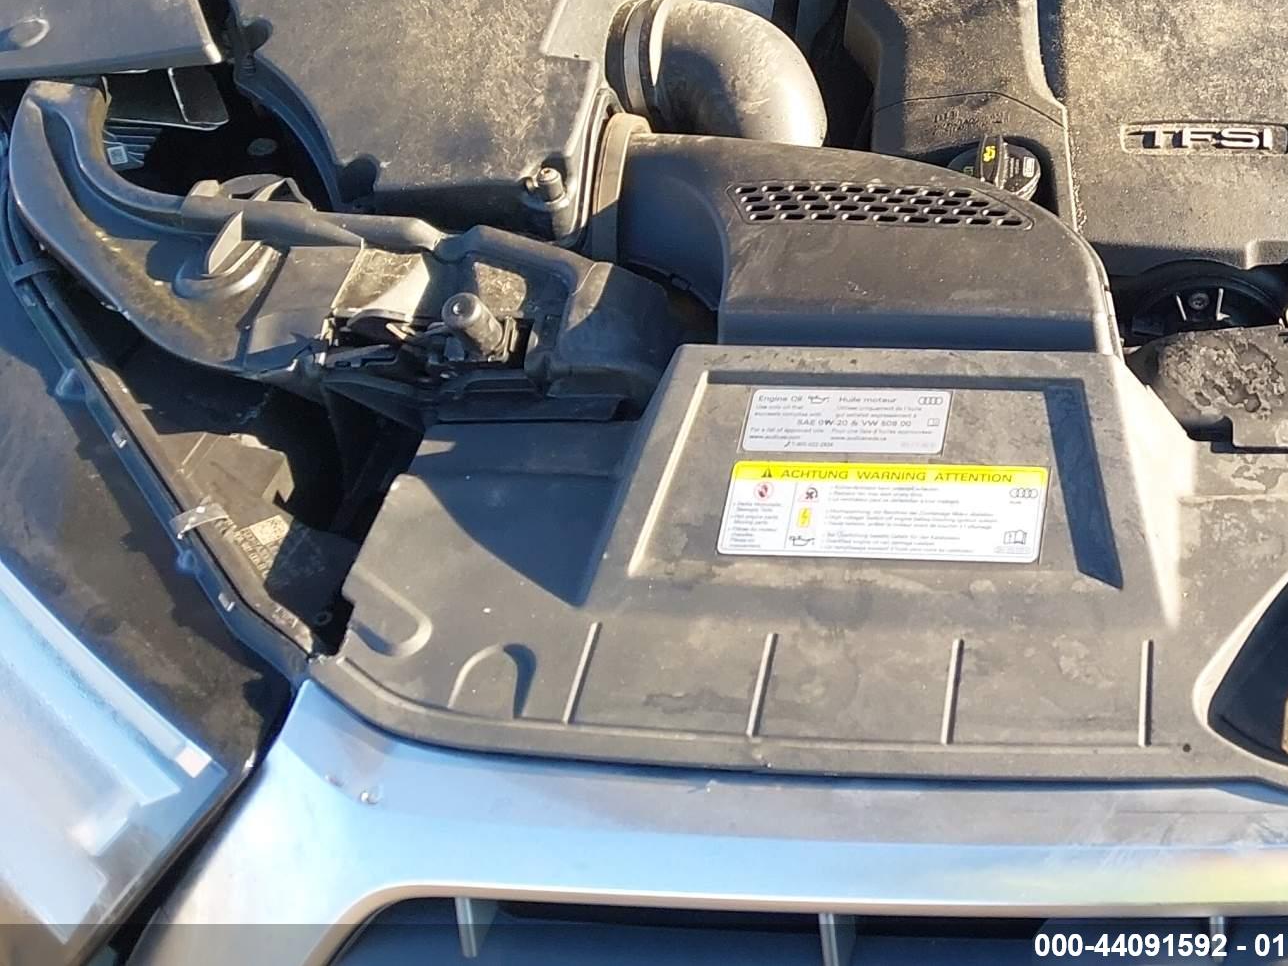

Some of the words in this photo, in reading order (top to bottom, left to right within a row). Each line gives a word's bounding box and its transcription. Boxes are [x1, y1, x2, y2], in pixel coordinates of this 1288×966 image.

[1136, 126, 1275, 150] TFSI
[758, 395, 788, 403] Engine
[862, 419, 879, 427] VW
[780, 469, 849, 480] ACHTUNG
[857, 470, 927, 481] WARNING
[934, 472, 1013, 483] ATTENTION
